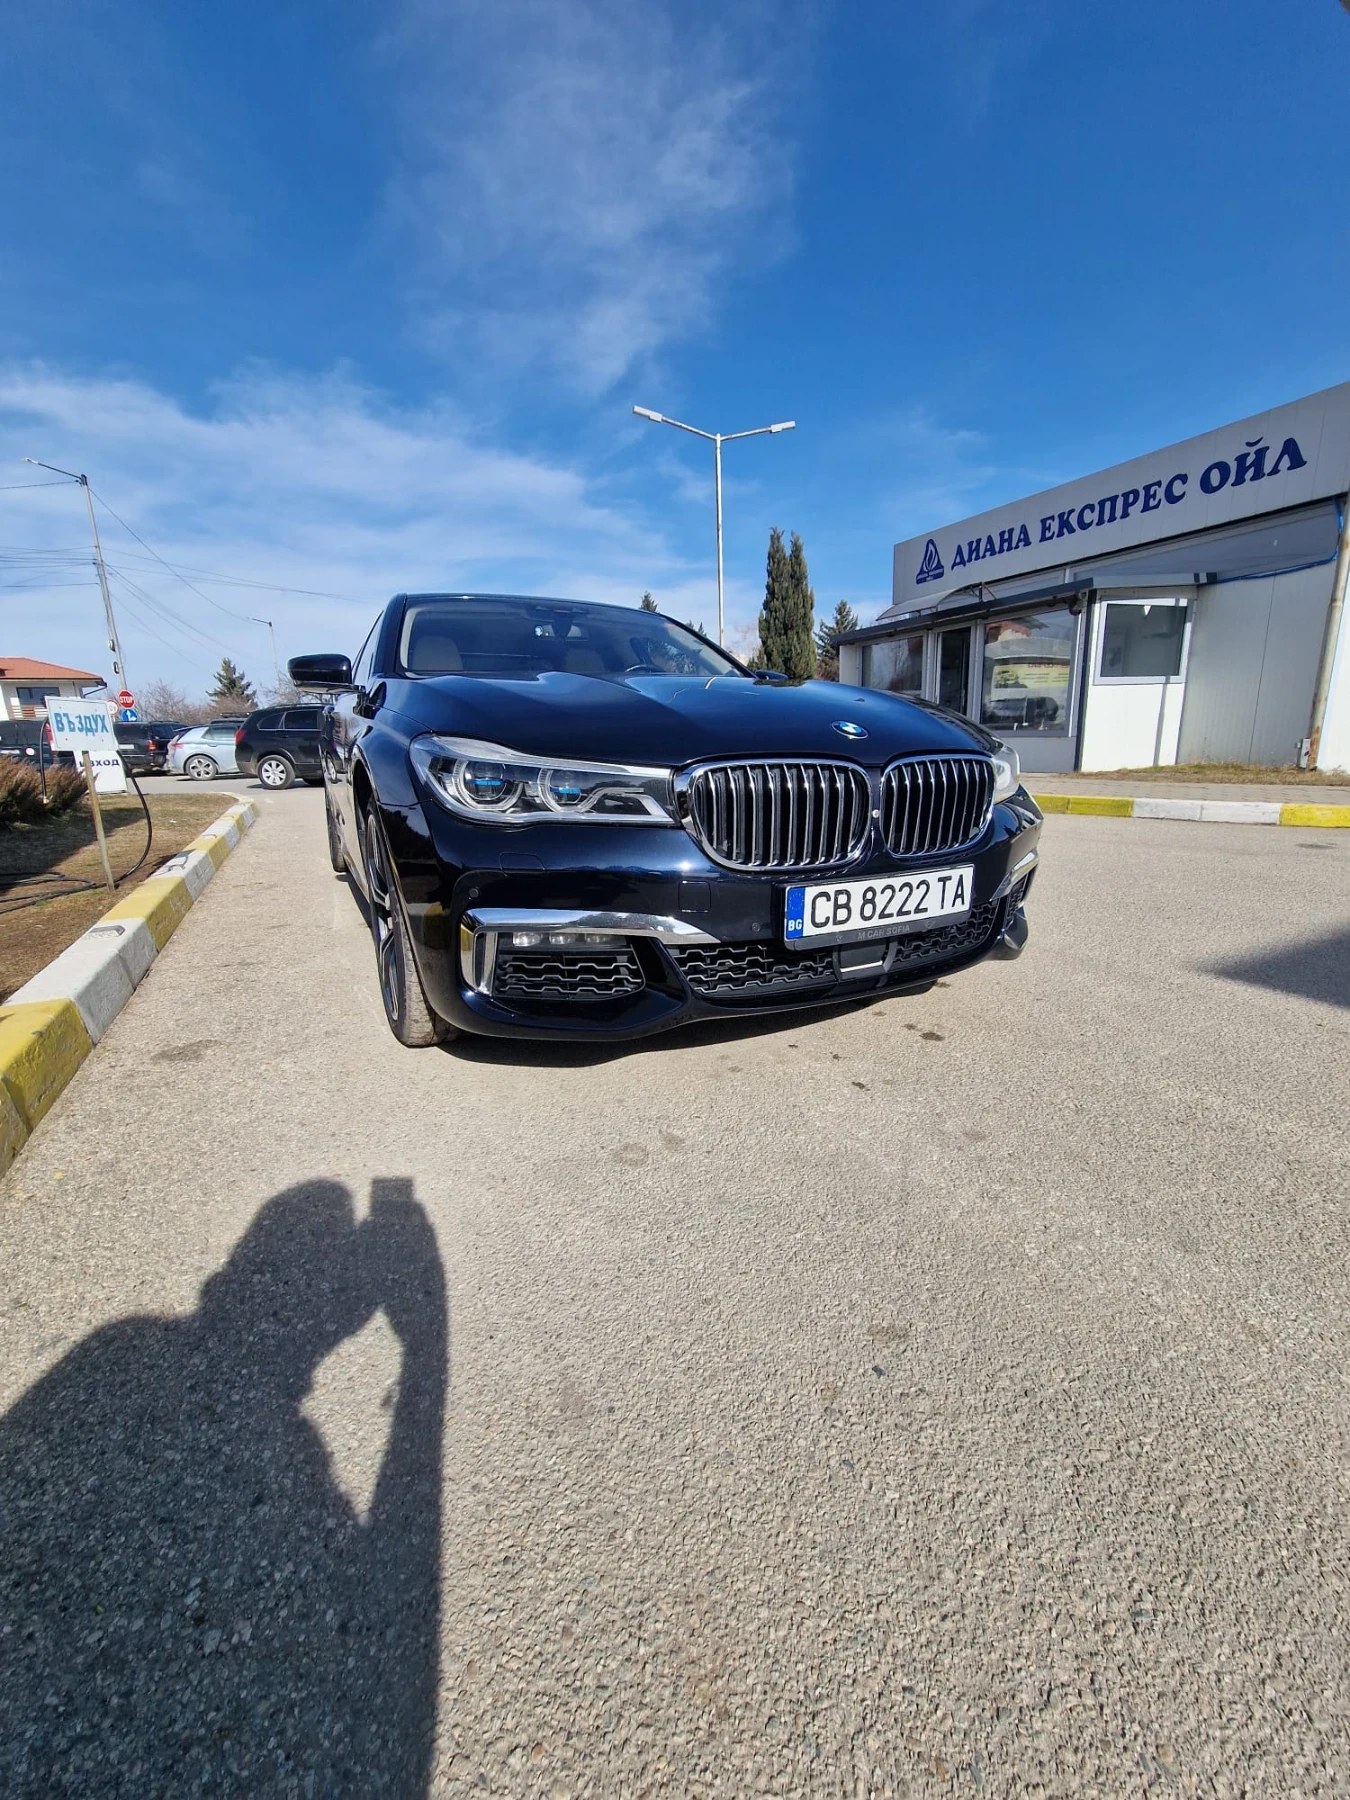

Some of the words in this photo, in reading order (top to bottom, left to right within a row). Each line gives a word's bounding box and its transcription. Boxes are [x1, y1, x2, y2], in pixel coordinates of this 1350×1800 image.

[951, 524, 1032, 571] ДИАНА
[1039, 473, 1188, 543] ЕКСПРЕС
[1200, 437, 1307, 495] ОЙЛ
[119, 696, 133, 704] STOP
[53, 712, 109, 736] ВЪЗДУХ
[811, 889, 851, 928] CB
[860, 879, 931, 921] 8222
[938, 874, 965, 910] TA
[788, 919, 803, 931] BG
[886, 924, 910, 936] SOFIA
